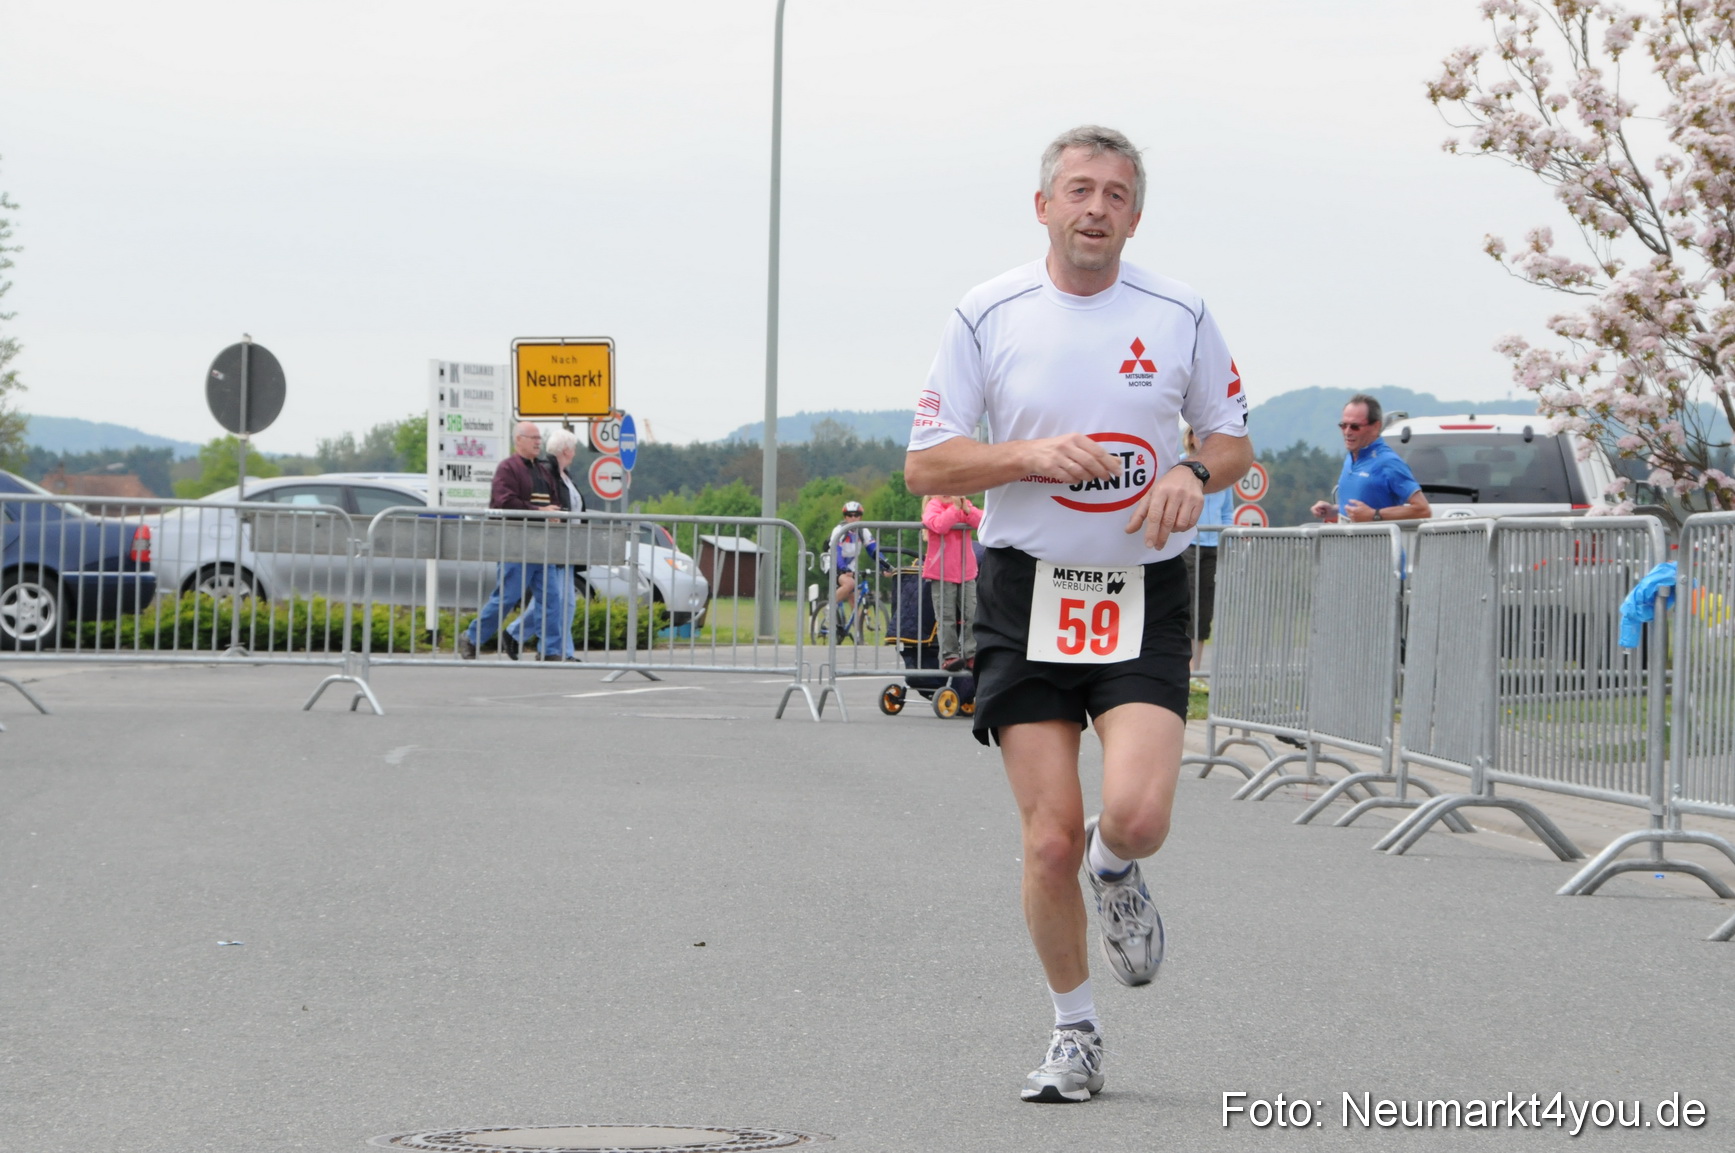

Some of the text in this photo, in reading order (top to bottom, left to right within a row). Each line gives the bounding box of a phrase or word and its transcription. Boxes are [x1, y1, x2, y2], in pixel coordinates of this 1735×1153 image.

[551, 355, 578, 364] Nach
[526, 370, 603, 387] Neumarkt
[552, 394, 579, 403] 5 km
[600, 423, 620, 441] 60
[447, 464, 471, 482] THULE
[1242, 473, 1260, 490] 60
[1053, 567, 1103, 583] MEYER
[1053, 579, 1103, 592] WERBUNG
[1057, 597, 1120, 656] 59
